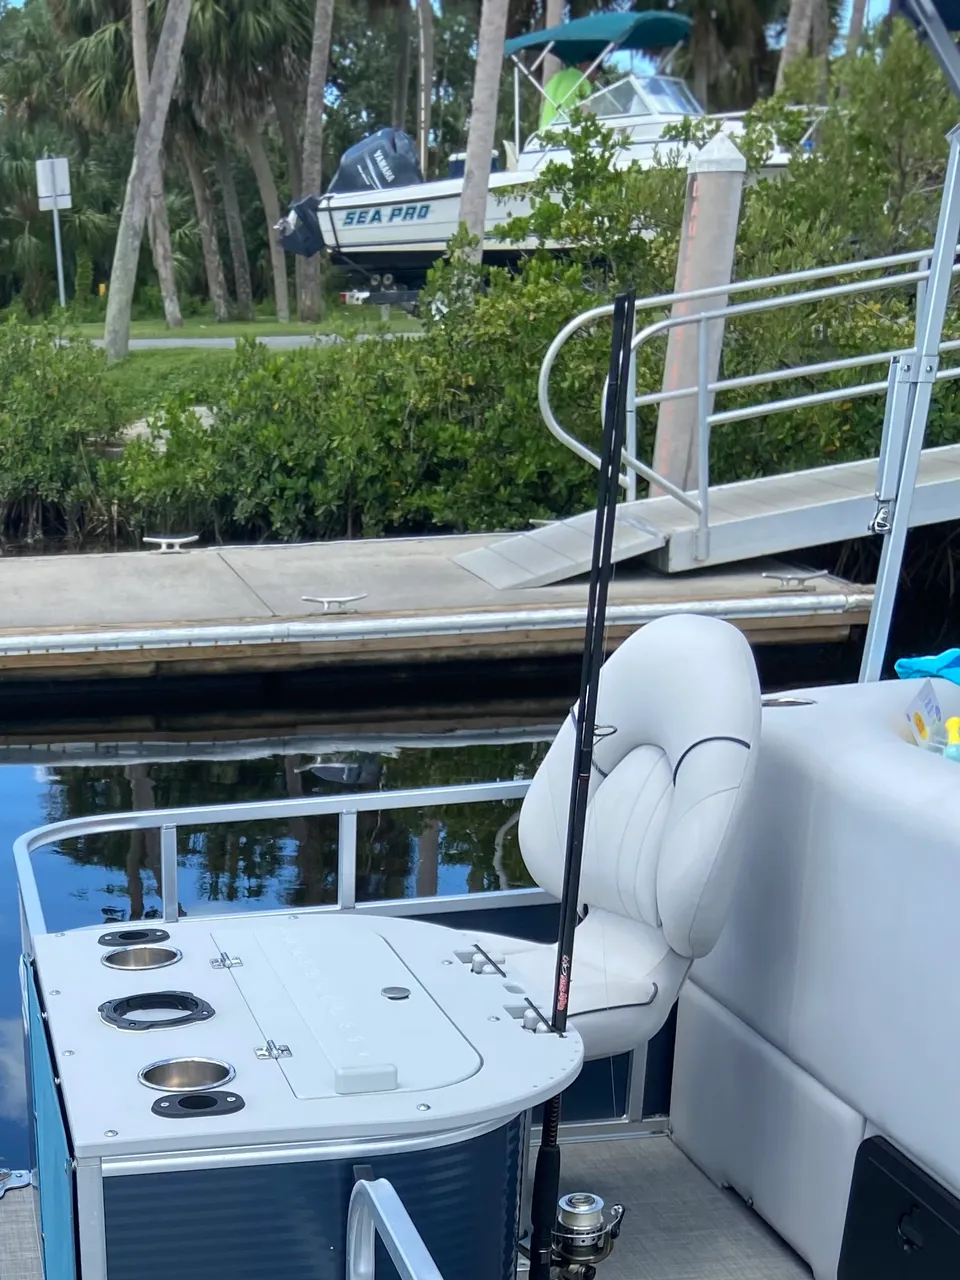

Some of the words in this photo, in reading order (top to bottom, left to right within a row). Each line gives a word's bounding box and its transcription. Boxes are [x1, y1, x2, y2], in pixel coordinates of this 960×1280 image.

[373, 149, 396, 183] YAMAHA
[343, 208, 382, 226] SEA
[388, 204, 431, 222] PRO
